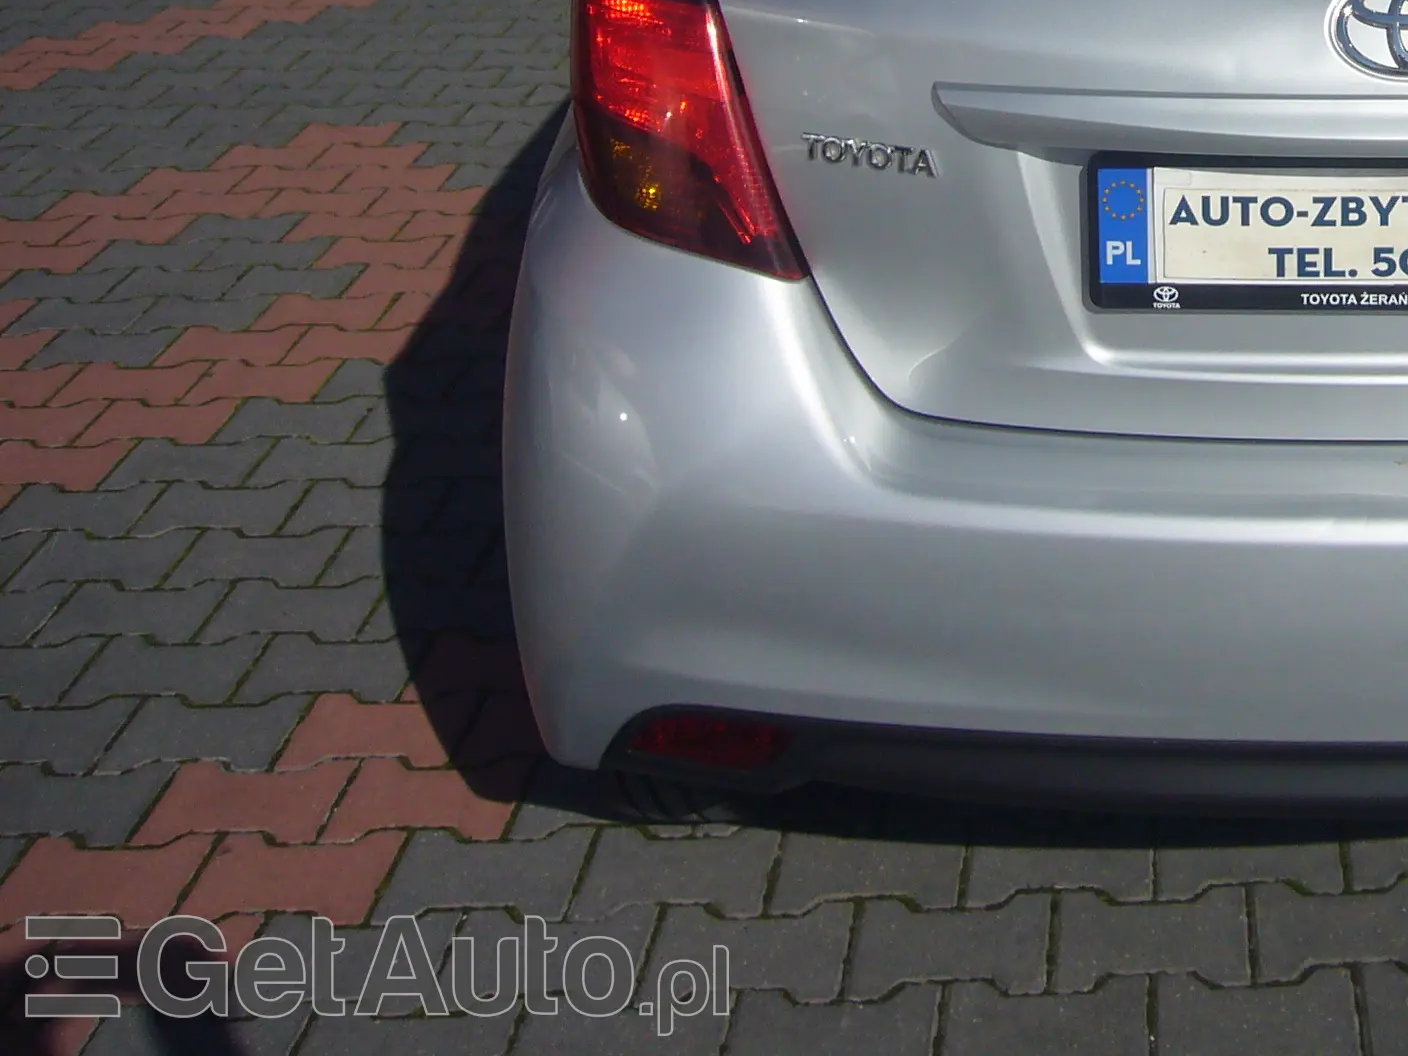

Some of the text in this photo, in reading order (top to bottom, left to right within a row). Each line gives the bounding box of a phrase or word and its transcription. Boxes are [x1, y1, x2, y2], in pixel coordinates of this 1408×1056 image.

[801, 132, 938, 178] TOYOTA
[1106, 241, 1141, 265] PL
[1268, 247, 1358, 277] TEL.
[1301, 293, 1357, 305] TOYOTA
[1360, 291, 1408, 305] ŻERAŃ
